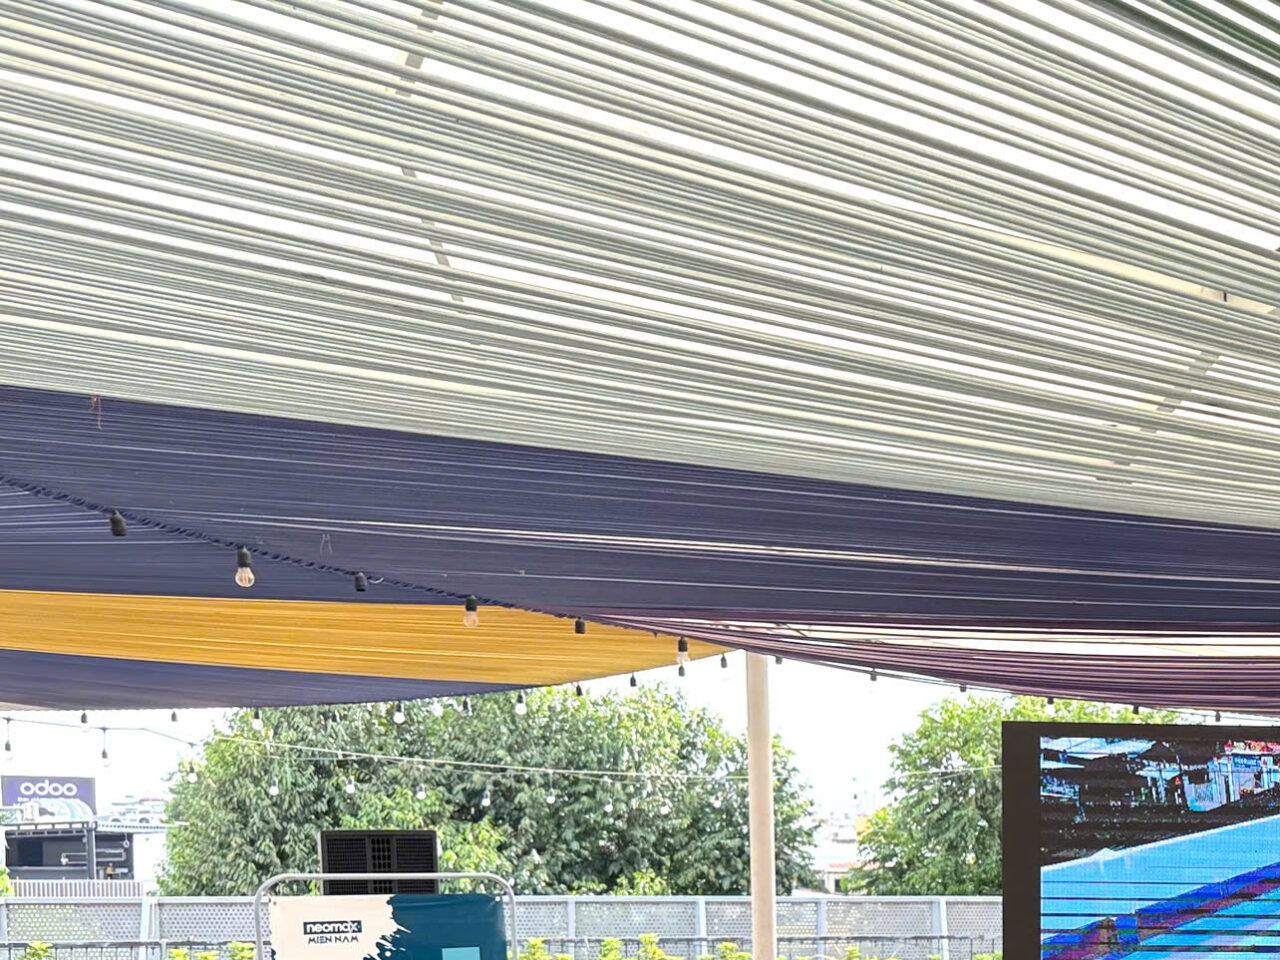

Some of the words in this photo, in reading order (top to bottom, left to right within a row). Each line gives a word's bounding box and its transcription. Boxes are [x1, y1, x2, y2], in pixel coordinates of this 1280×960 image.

[20, 780, 77, 796] odoo
[305, 921, 360, 934] neomax
[334, 935, 359, 944] NAM
